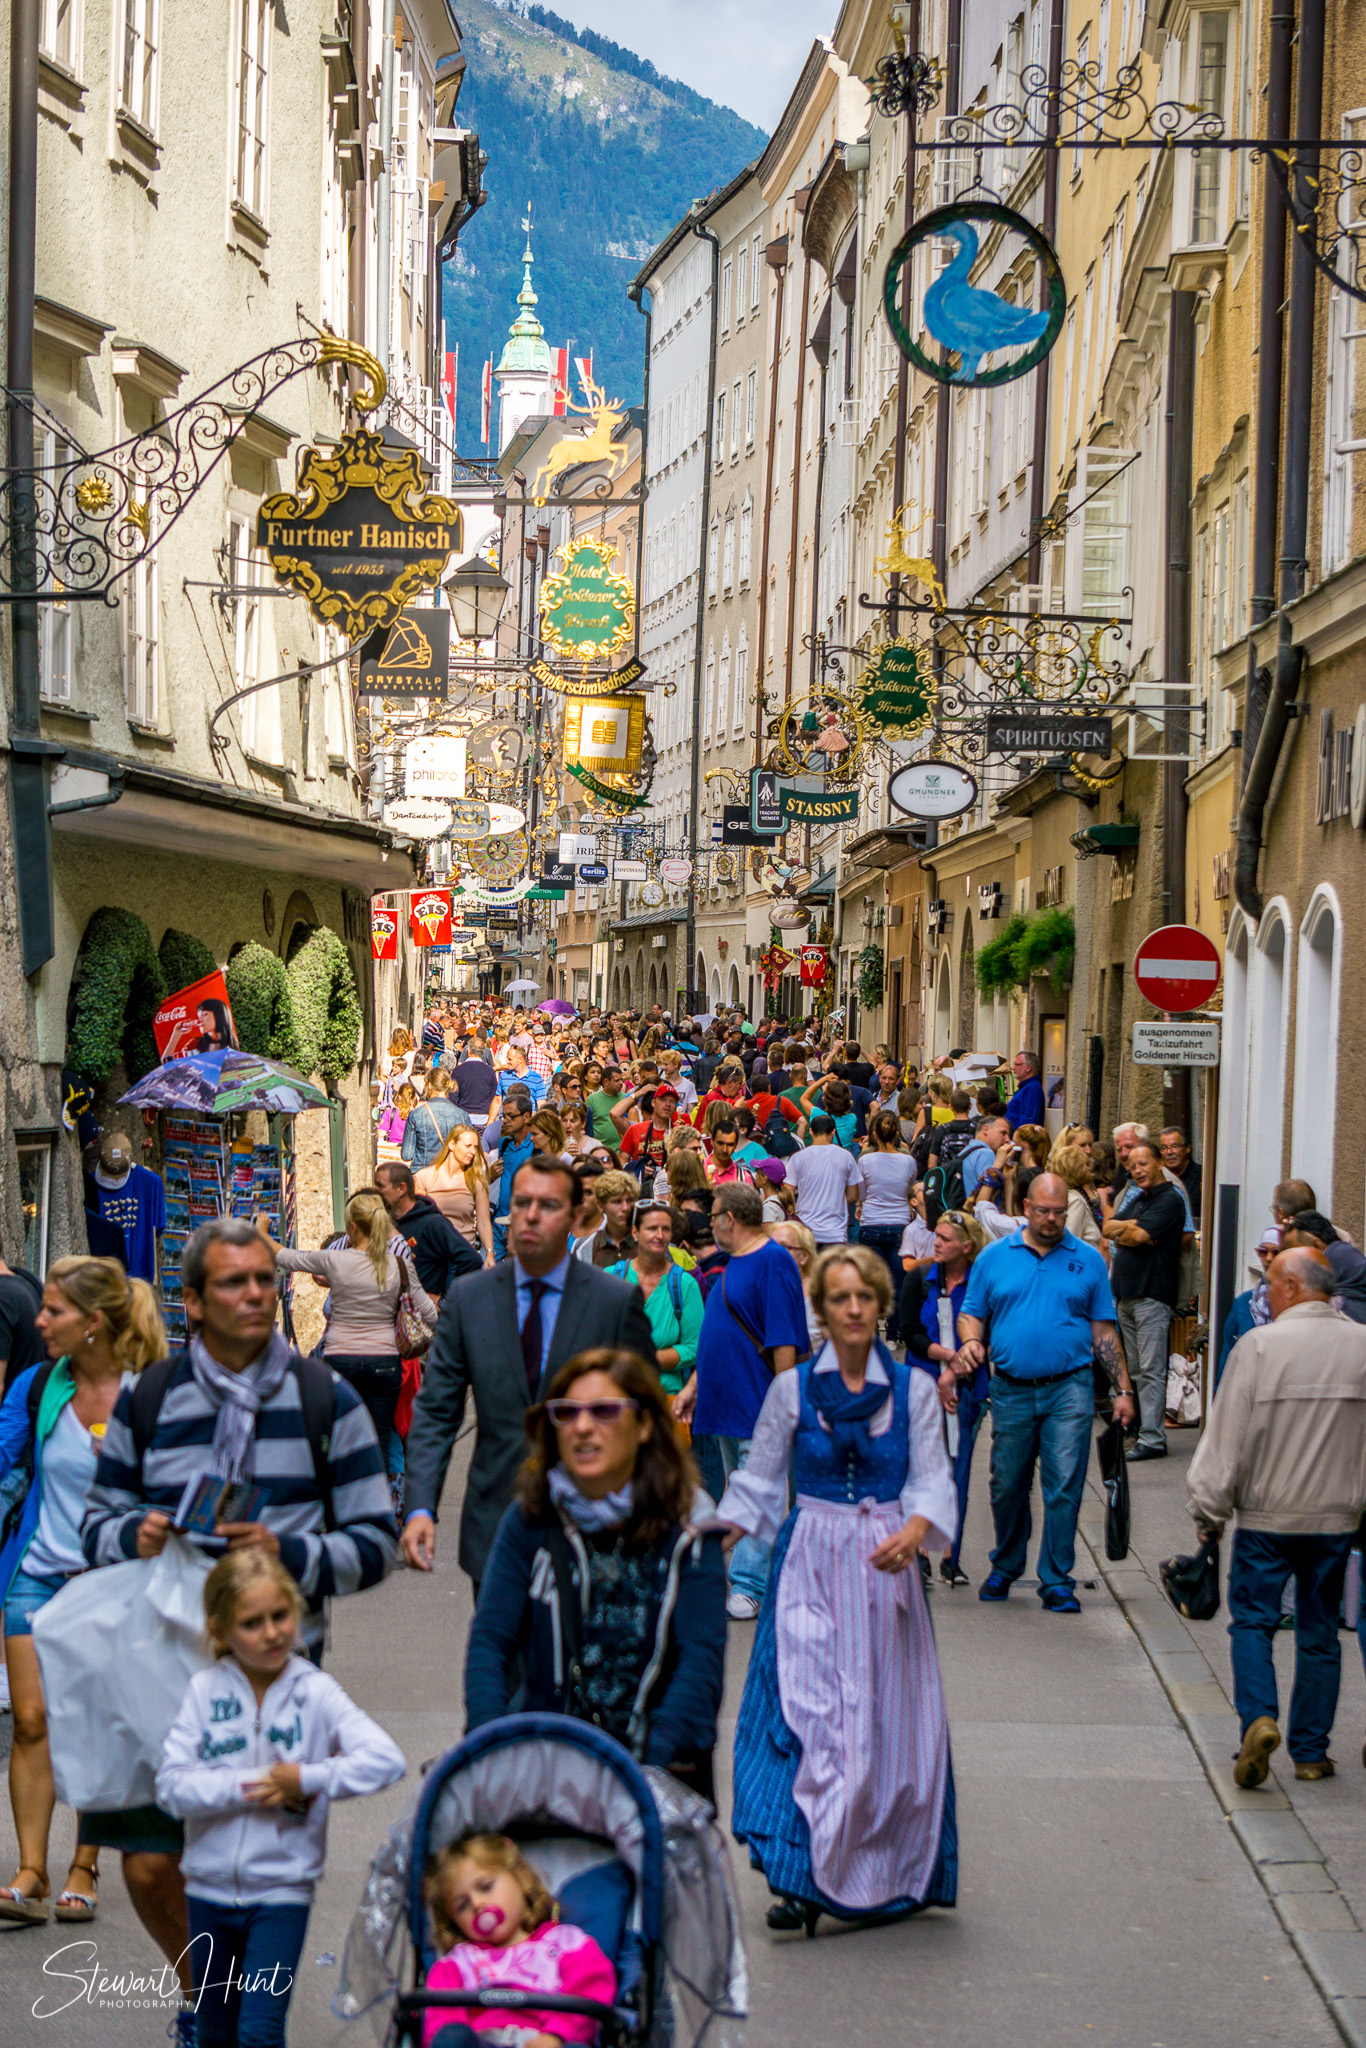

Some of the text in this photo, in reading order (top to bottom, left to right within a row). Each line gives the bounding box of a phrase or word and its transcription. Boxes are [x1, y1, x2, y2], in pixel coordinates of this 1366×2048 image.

[267, 522, 450, 549] Furtner Hanisch
[331, 563, 384, 576] seit 1955
[570, 563, 606, 579] Hotel
[562, 588, 616, 603] Goldener
[883, 659, 914, 673] Hotel
[366, 674, 441, 686] CRYSTALP
[529, 659, 641, 695] Kupferschmiedhaus
[874, 679, 919, 694] Goldener
[876, 699, 913, 715] Hirsch
[995, 728, 1105, 747] SPIRITUOSEN
[578, 771, 637, 805] DENKSTEIN
[908, 788, 956, 796] GMUNDNER
[786, 797, 852, 817] STASSNY
[389, 811, 447, 822] Dantendorfer
[727, 821, 750, 830] GE
[576, 847, 595, 856] IRB
[542, 873, 572, 881] SWAROVSKI
[582, 867, 606, 875] Berlitz
[419, 893, 442, 904] FRISCH
[471, 889, 523, 902] Aschauer
[372, 912, 391, 921] RISCH
[416, 904, 447, 918] EIS
[803, 953, 822, 962] EIS
[1138, 1028, 1212, 1038] ausgenommen
[1148, 1039, 1203, 1048] Taxizufahrt
[1134, 1050, 1216, 1061] Goldener Hirsch
